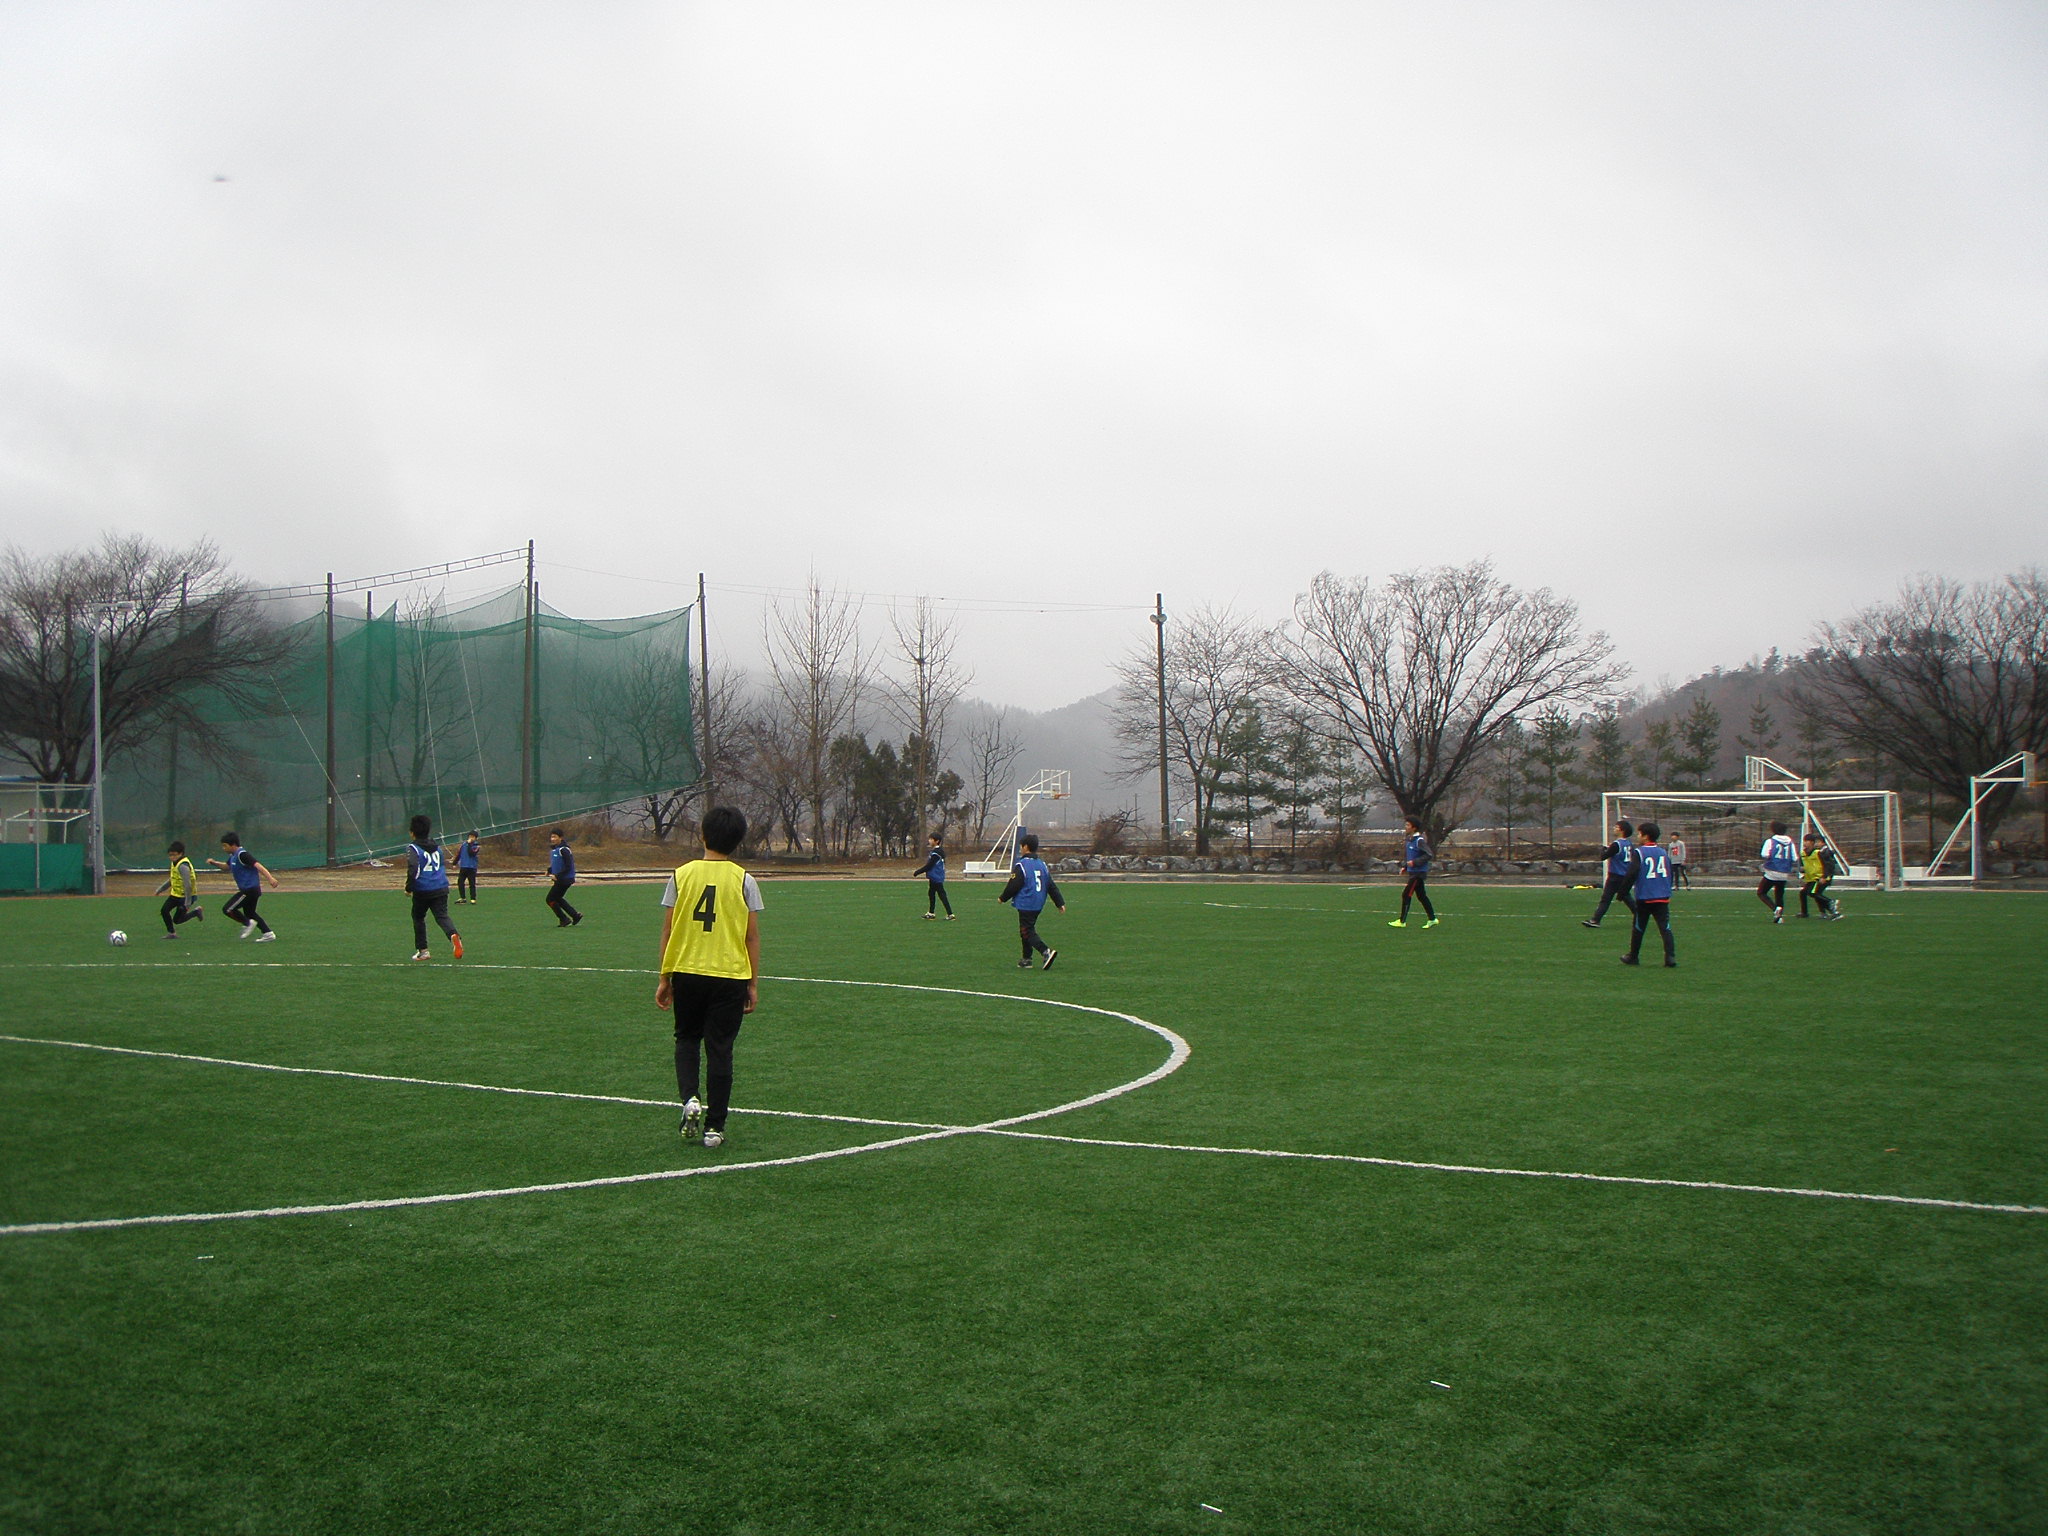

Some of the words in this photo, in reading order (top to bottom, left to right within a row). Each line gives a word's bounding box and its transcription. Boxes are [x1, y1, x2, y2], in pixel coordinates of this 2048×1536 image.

[423, 850, 440, 871] 29
[1775, 843, 1790, 859] 21
[1645, 855, 1668, 879] 24
[1034, 870, 1042, 892] 5
[692, 884, 717, 932] 4
